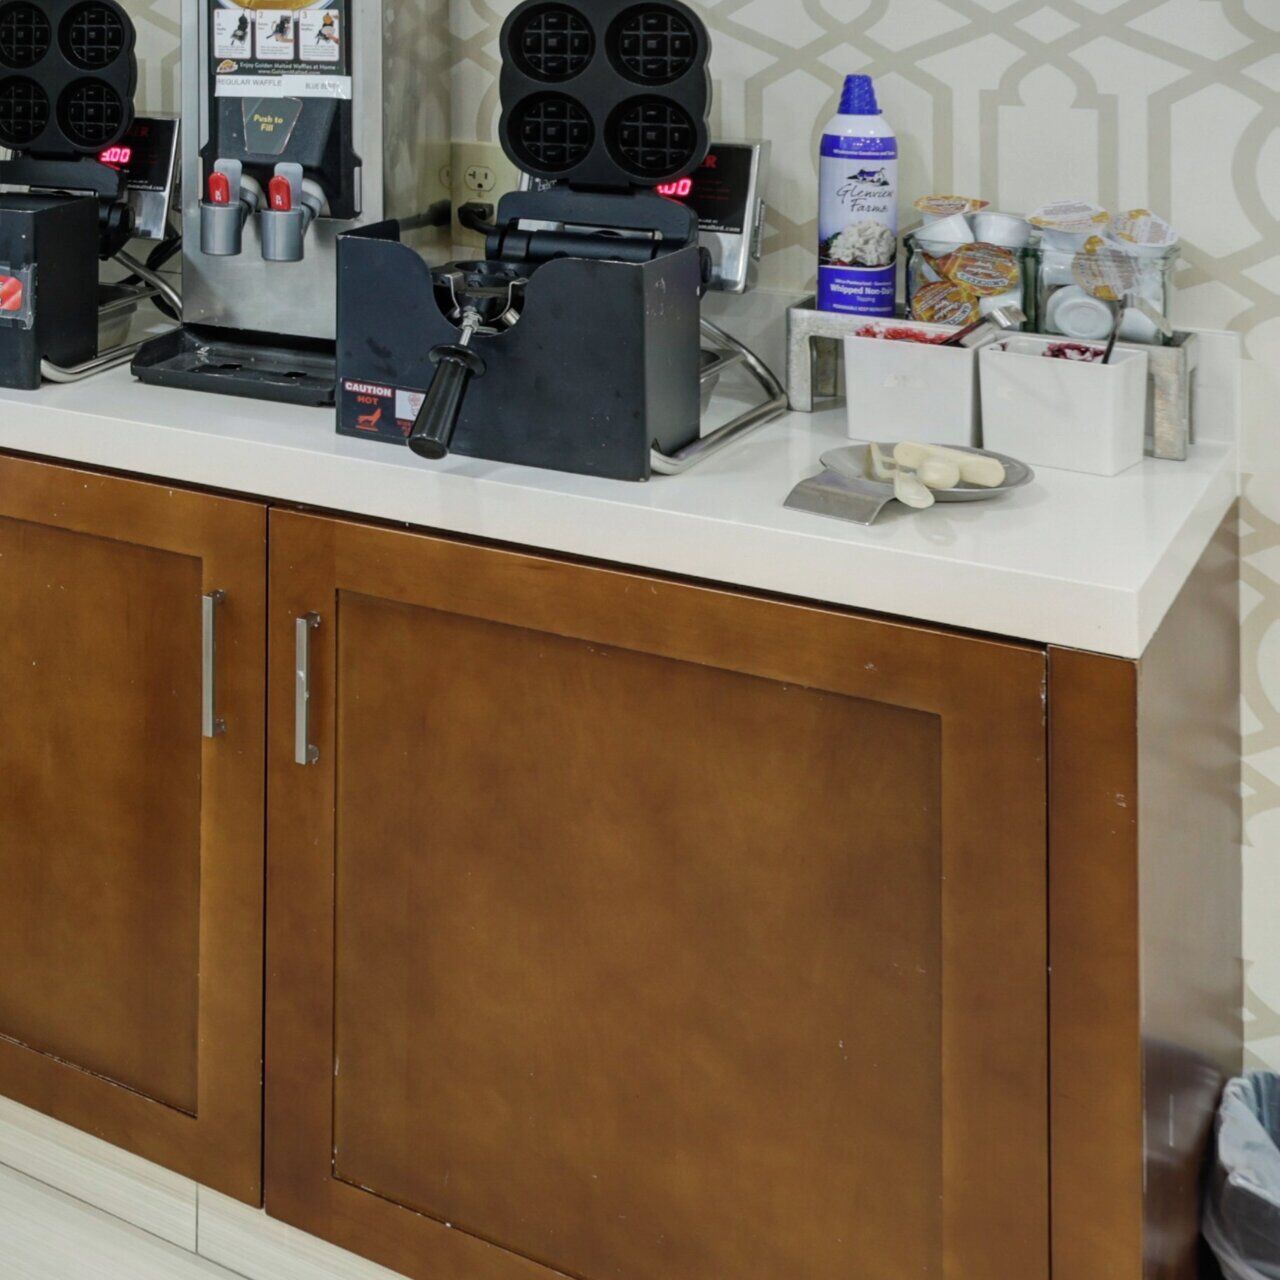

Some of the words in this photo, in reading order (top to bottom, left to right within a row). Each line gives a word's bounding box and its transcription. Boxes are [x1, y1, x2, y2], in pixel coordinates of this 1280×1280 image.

[253, 79, 282, 87] WAFFLE
[253, 114, 273, 123] Push
[274, 116, 284, 124] to
[260, 123, 274, 132] Fill
[851, 198, 887, 213] Farms
[830, 283, 864, 295] Whipped
[344, 381, 393, 398] CAUTION
[356, 395, 378, 405] HOT
